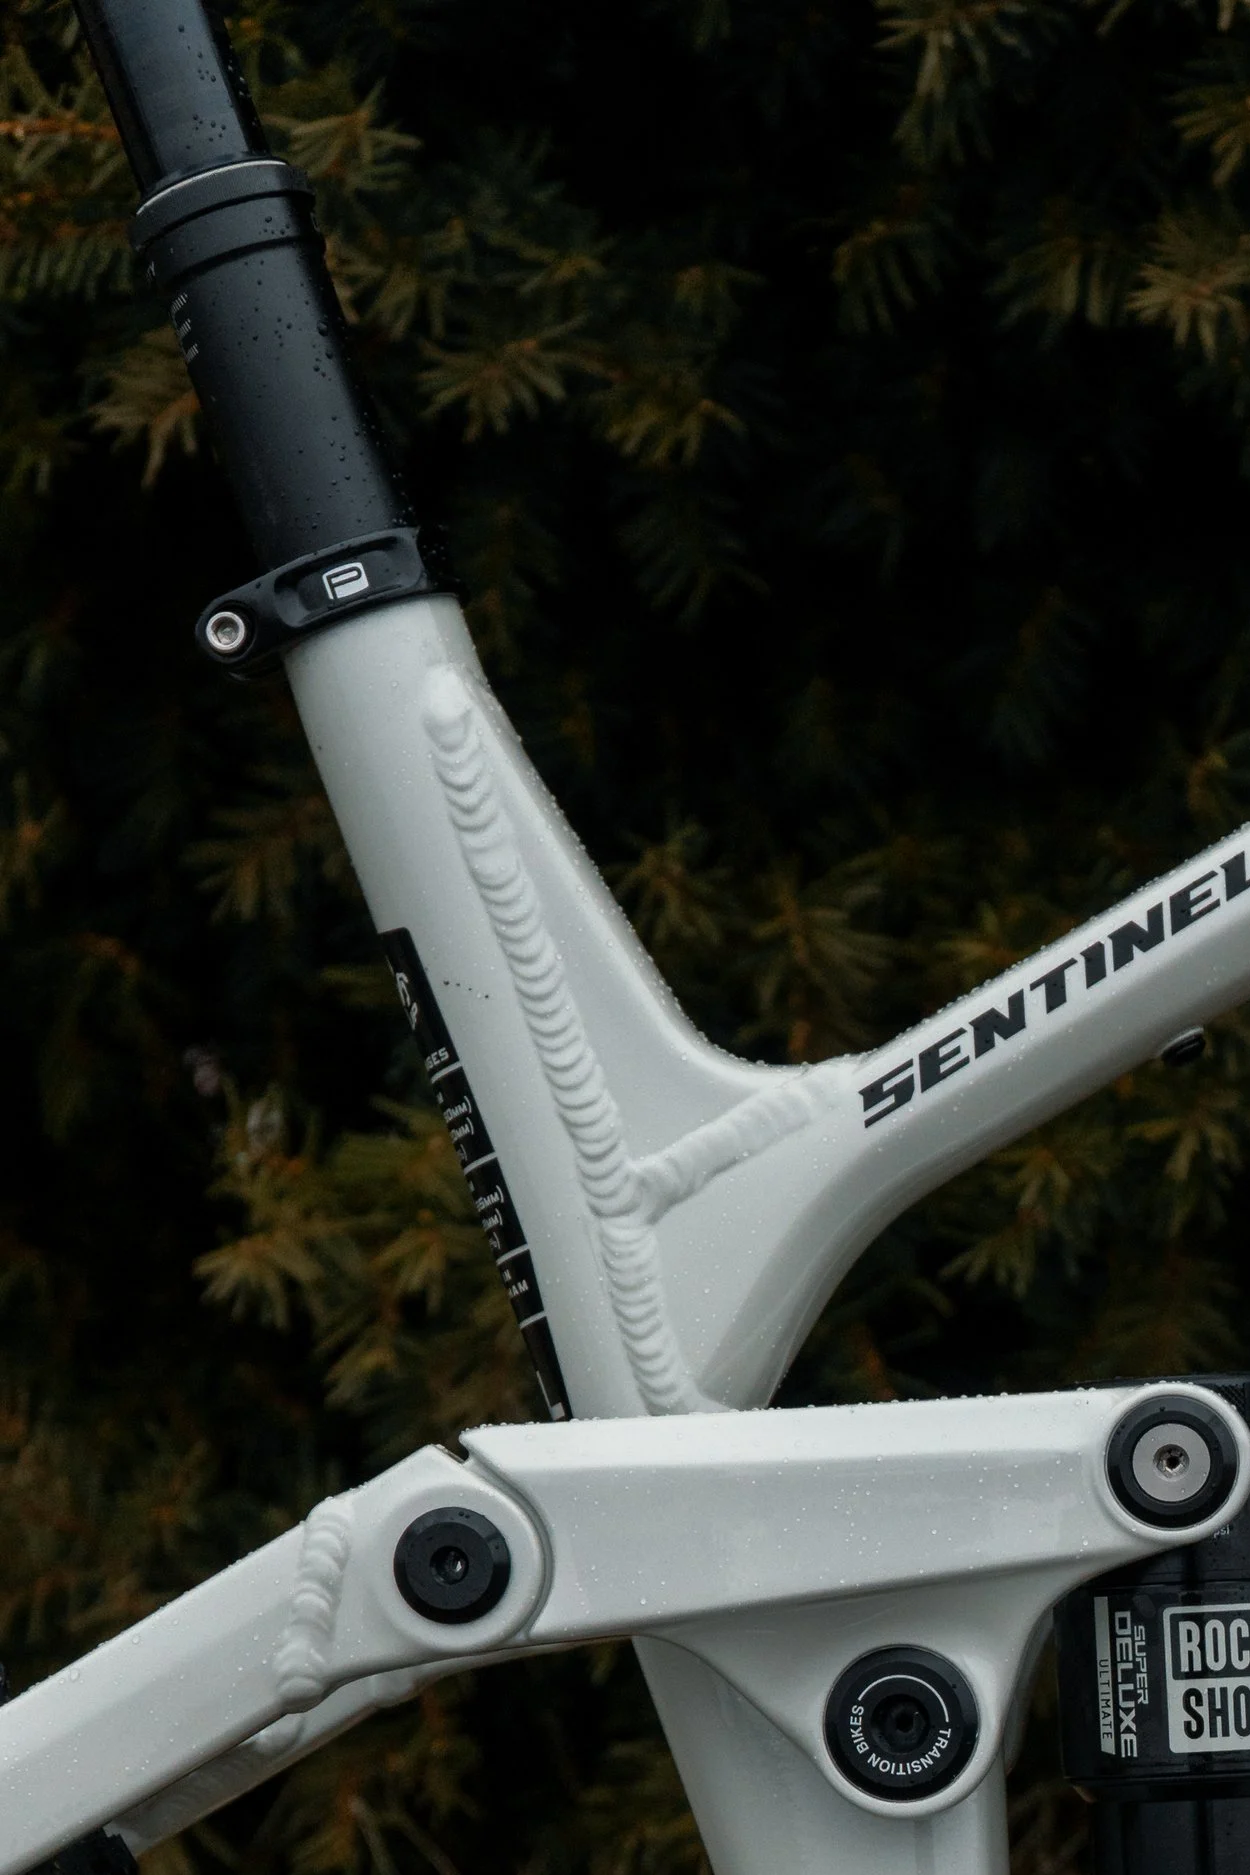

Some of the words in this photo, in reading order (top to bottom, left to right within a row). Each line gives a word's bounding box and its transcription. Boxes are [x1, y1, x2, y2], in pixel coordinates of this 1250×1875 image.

[1099, 1658, 1113, 1740] ULTIMATE
[1114, 1610, 1138, 1758] DELUXE
[1133, 1624, 1149, 1705] SUPER
[849, 1704, 870, 1754] BIKES
[866, 1727, 952, 1776] TRANSITION
